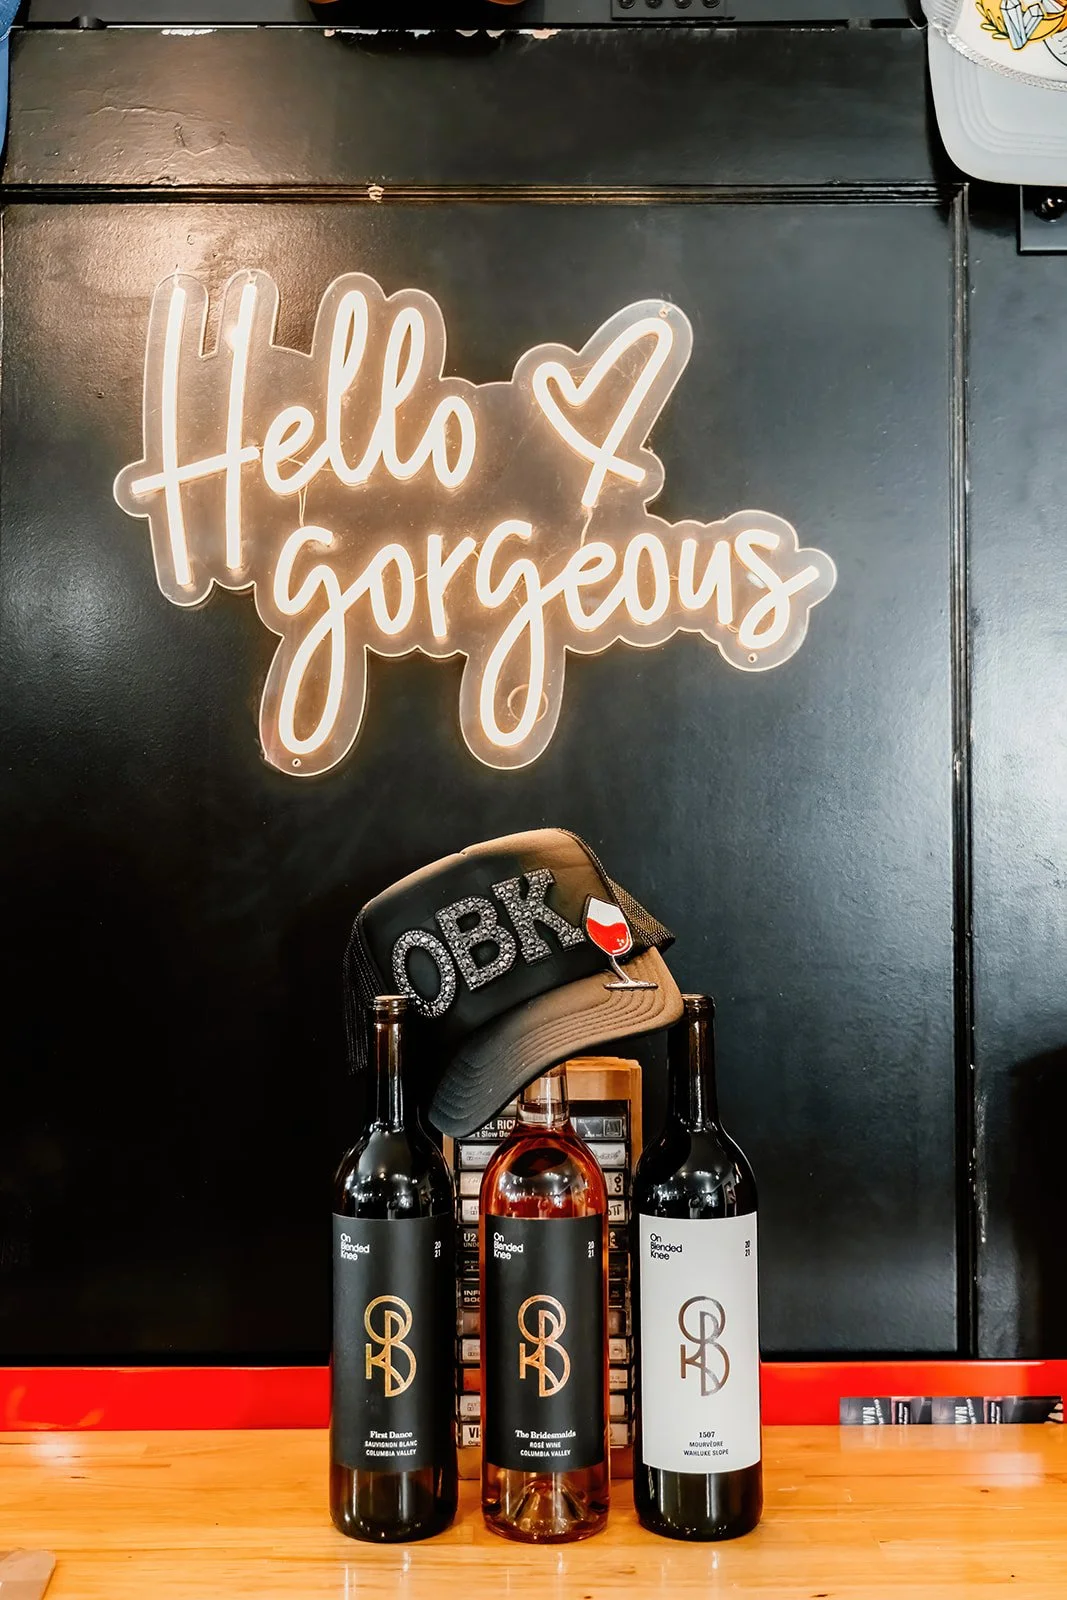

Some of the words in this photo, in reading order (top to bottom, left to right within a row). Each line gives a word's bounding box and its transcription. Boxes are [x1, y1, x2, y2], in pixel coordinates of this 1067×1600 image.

[131, 283, 478, 588] Hello
[272, 519, 820, 756] gorgeous
[391, 867, 587, 1018] OBK
[481, 1130, 498, 1138] Slow
[340, 1233, 351, 1243] On
[463, 1233, 477, 1242] U2
[493, 1232, 505, 1242] On
[650, 1233, 662, 1242] On
[340, 1241, 370, 1254] Blended
[434, 1241, 442, 1249] 20
[493, 1241, 524, 1253] Blended
[587, 1241, 595, 1249] 20
[650, 1241, 683, 1253] Blended
[340, 1250, 358, 1261] Knee
[434, 1249, 441, 1258] 21
[493, 1249, 511, 1260] Knee
[587, 1249, 595, 1258] 21
[650, 1250, 670, 1261] Knee
[369, 1430, 388, 1439] First
[388, 1431, 414, 1439] Dance
[514, 1429, 530, 1439] The
[530, 1430, 577, 1440] Bridesmaids
[364, 1440, 398, 1448] SAUVIGNON
[398, 1440, 418, 1448] BLANC
[545, 1441, 562, 1449] WINE
[365, 1449, 396, 1457] COLUMBIA
[396, 1448, 417, 1457] VALLEY
[520, 1449, 551, 1457] COLUMBIA
[550, 1449, 572, 1457] VALLEY
[712, 1448, 729, 1456] SLOPE
